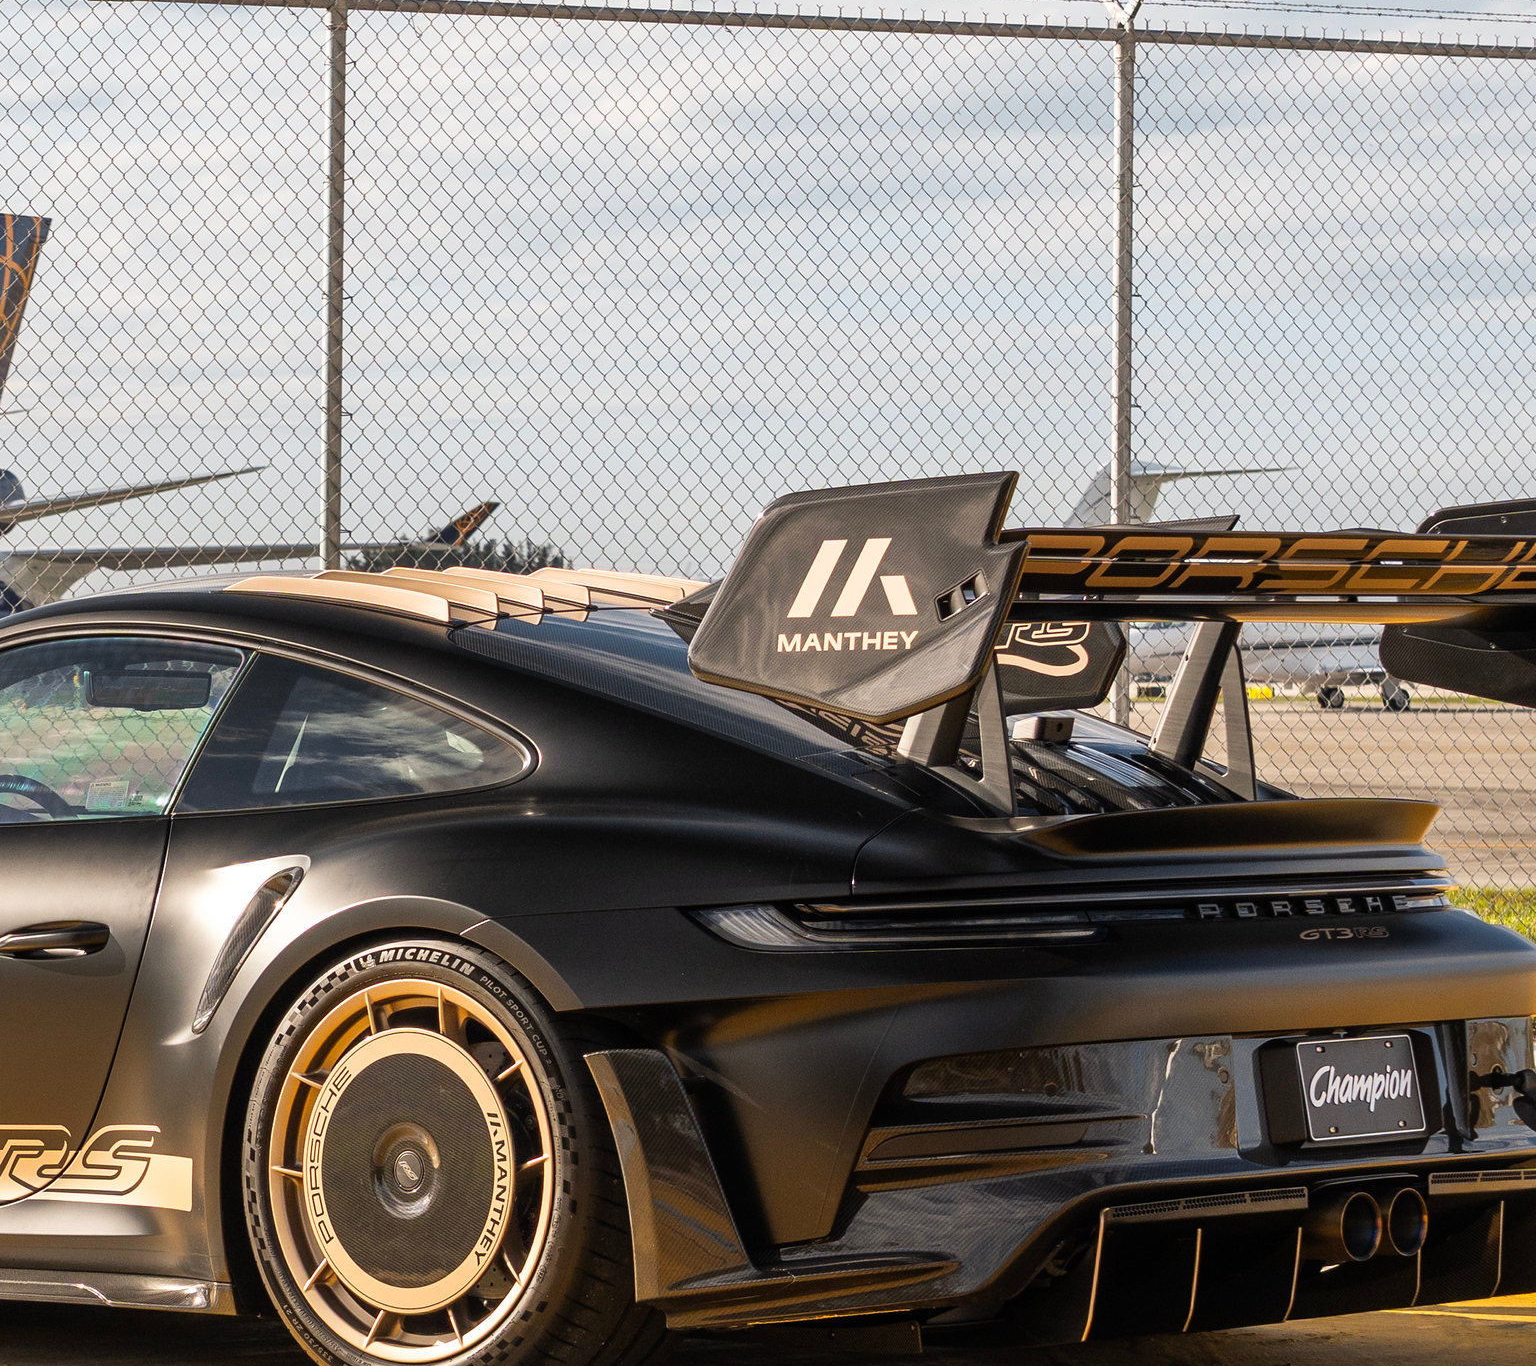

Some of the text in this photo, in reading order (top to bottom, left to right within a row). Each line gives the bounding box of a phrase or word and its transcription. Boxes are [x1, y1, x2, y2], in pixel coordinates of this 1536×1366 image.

[777, 630, 919, 653] MANTHEY
[1196, 894, 1410, 920] PORSCHE
[378, 947, 476, 977] MICHELIN
[480, 975, 508, 1000] PILOT
[506, 999, 535, 1031] SPORT
[532, 1034, 548, 1056] CUP
[1309, 1065, 1412, 1112] Champion
[309, 1066, 352, 1245] PORSCHE
[474, 1139, 508, 1266] MANTHEY
